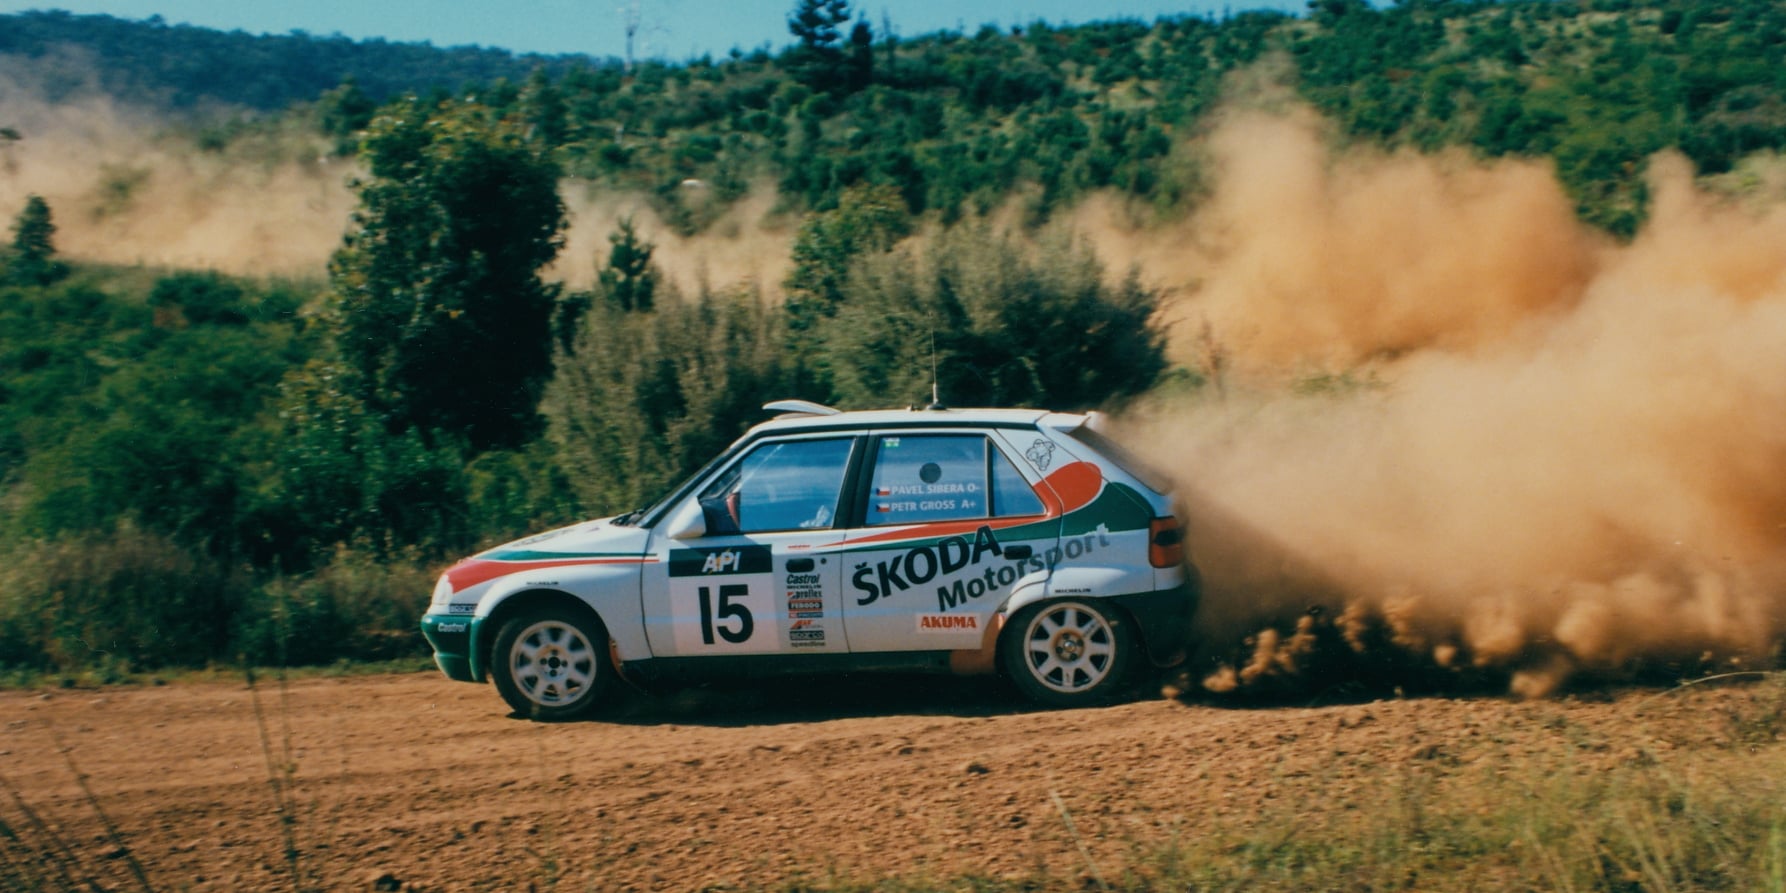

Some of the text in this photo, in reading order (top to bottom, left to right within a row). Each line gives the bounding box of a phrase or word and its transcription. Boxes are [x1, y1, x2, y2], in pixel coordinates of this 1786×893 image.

[891, 485, 925, 495] PAVEL
[927, 484, 965, 494] SIBERA
[891, 500, 976, 511] PETR GROSS A+
[702, 551, 742, 574] API
[852, 524, 1002, 606] ŠKODA
[937, 523, 1110, 612] Motorsport
[787, 574, 821, 584] Castrol
[698, 584, 754, 645] 15
[920, 615, 977, 629] AKUMA
